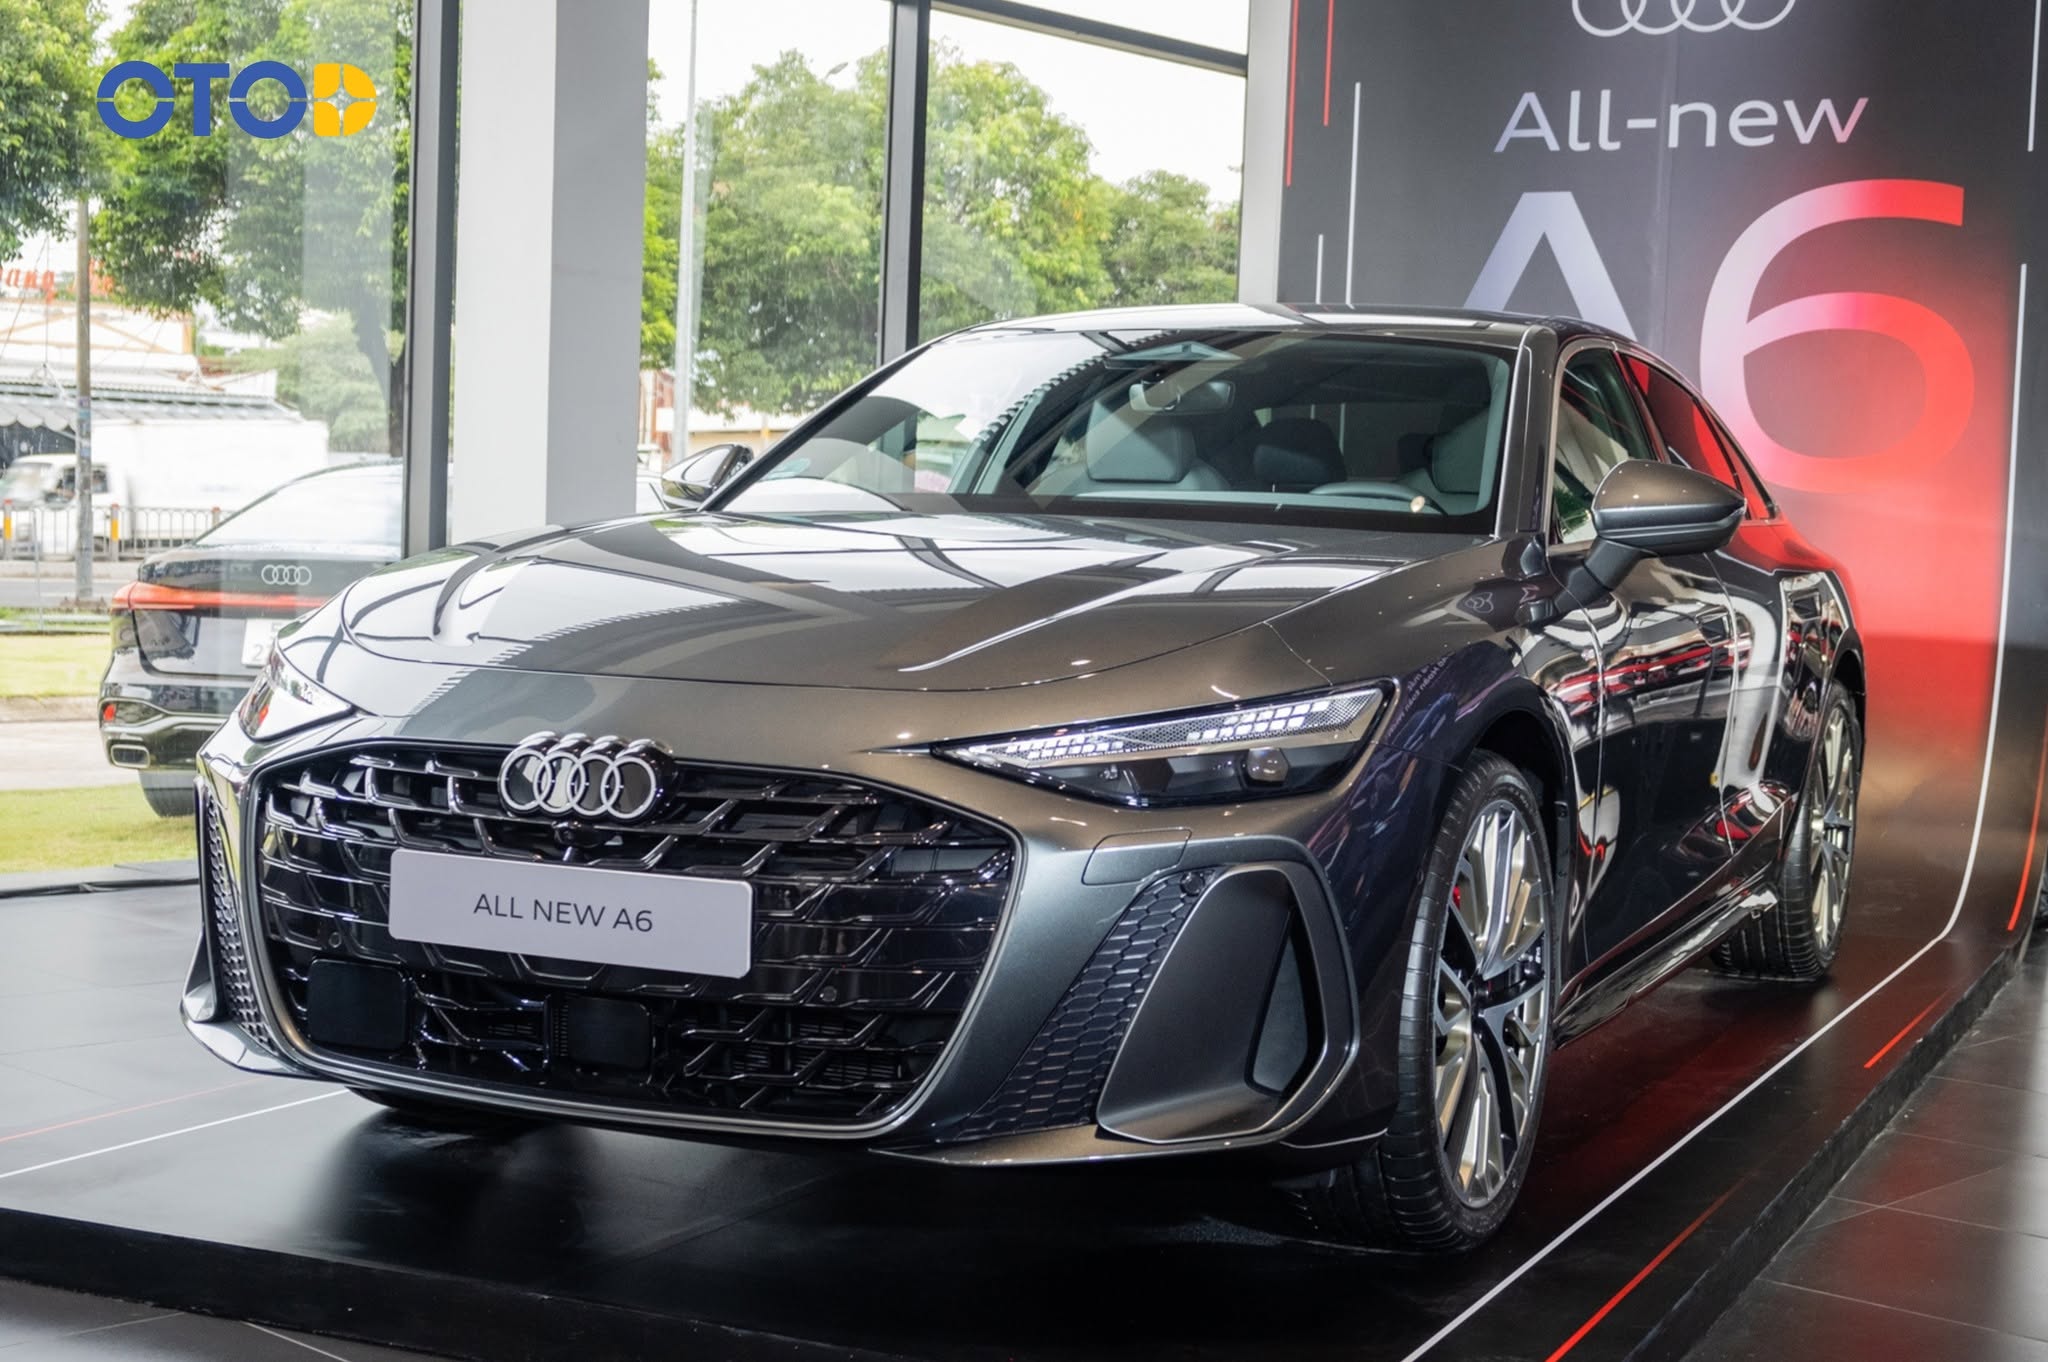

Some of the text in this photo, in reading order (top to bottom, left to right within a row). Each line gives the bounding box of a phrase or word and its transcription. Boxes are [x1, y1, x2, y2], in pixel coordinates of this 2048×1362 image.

[1495, 90, 1869, 152] All-new
[473, 893, 653, 933] ALL NEW A6
